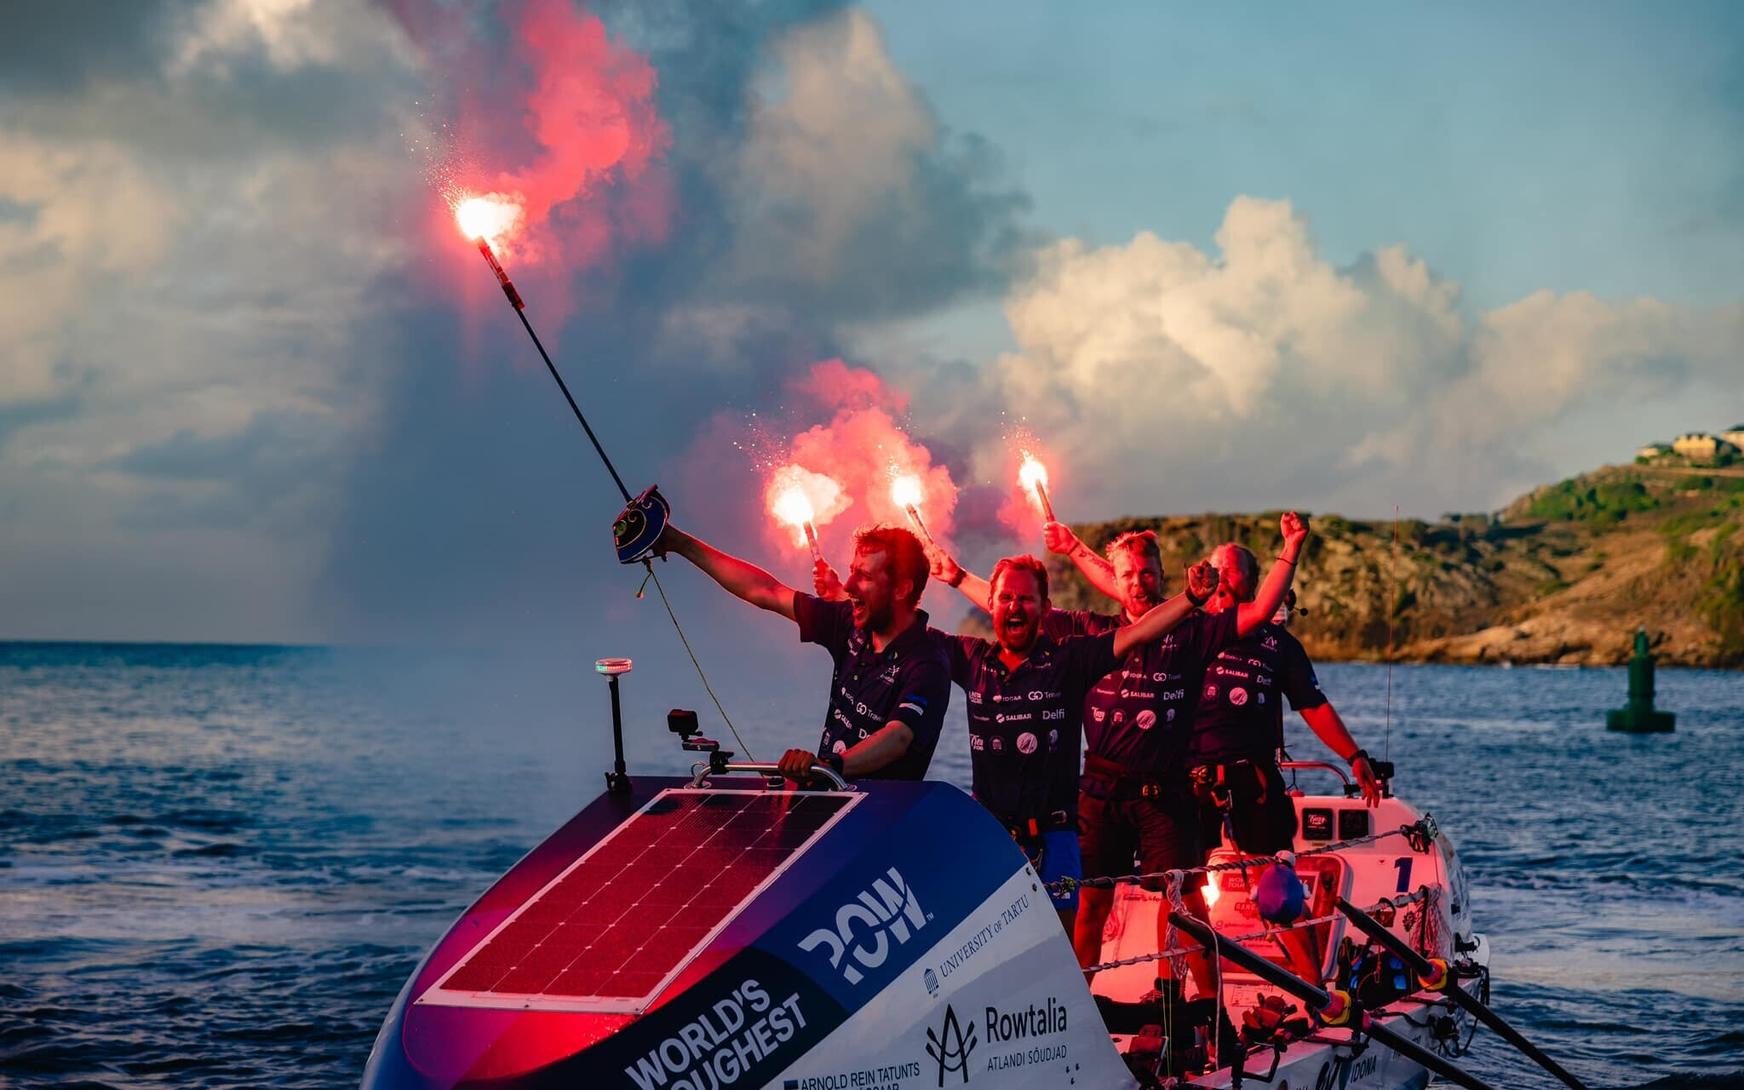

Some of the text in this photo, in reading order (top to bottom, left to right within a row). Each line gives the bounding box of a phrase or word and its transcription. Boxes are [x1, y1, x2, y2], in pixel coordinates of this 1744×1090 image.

[1005, 713, 1032, 721] SALIBAR
[1042, 708, 1065, 720] Delfi
[1394, 858, 1413, 893] 1
[797, 866, 927, 985] POW
[940, 924, 993, 977] UNIVERSITY
[1000, 893, 1029, 926] TARTU
[624, 979, 771, 1090] WORLD'S
[985, 997, 1067, 1043] Rowtalia
[987, 1044, 1067, 1072] ATLANDI SÕUDJAD
[801, 1073, 848, 1090] ARNOLD
[850, 1069, 876, 1088] REIN
[877, 1062, 920, 1083] TATUNTS
